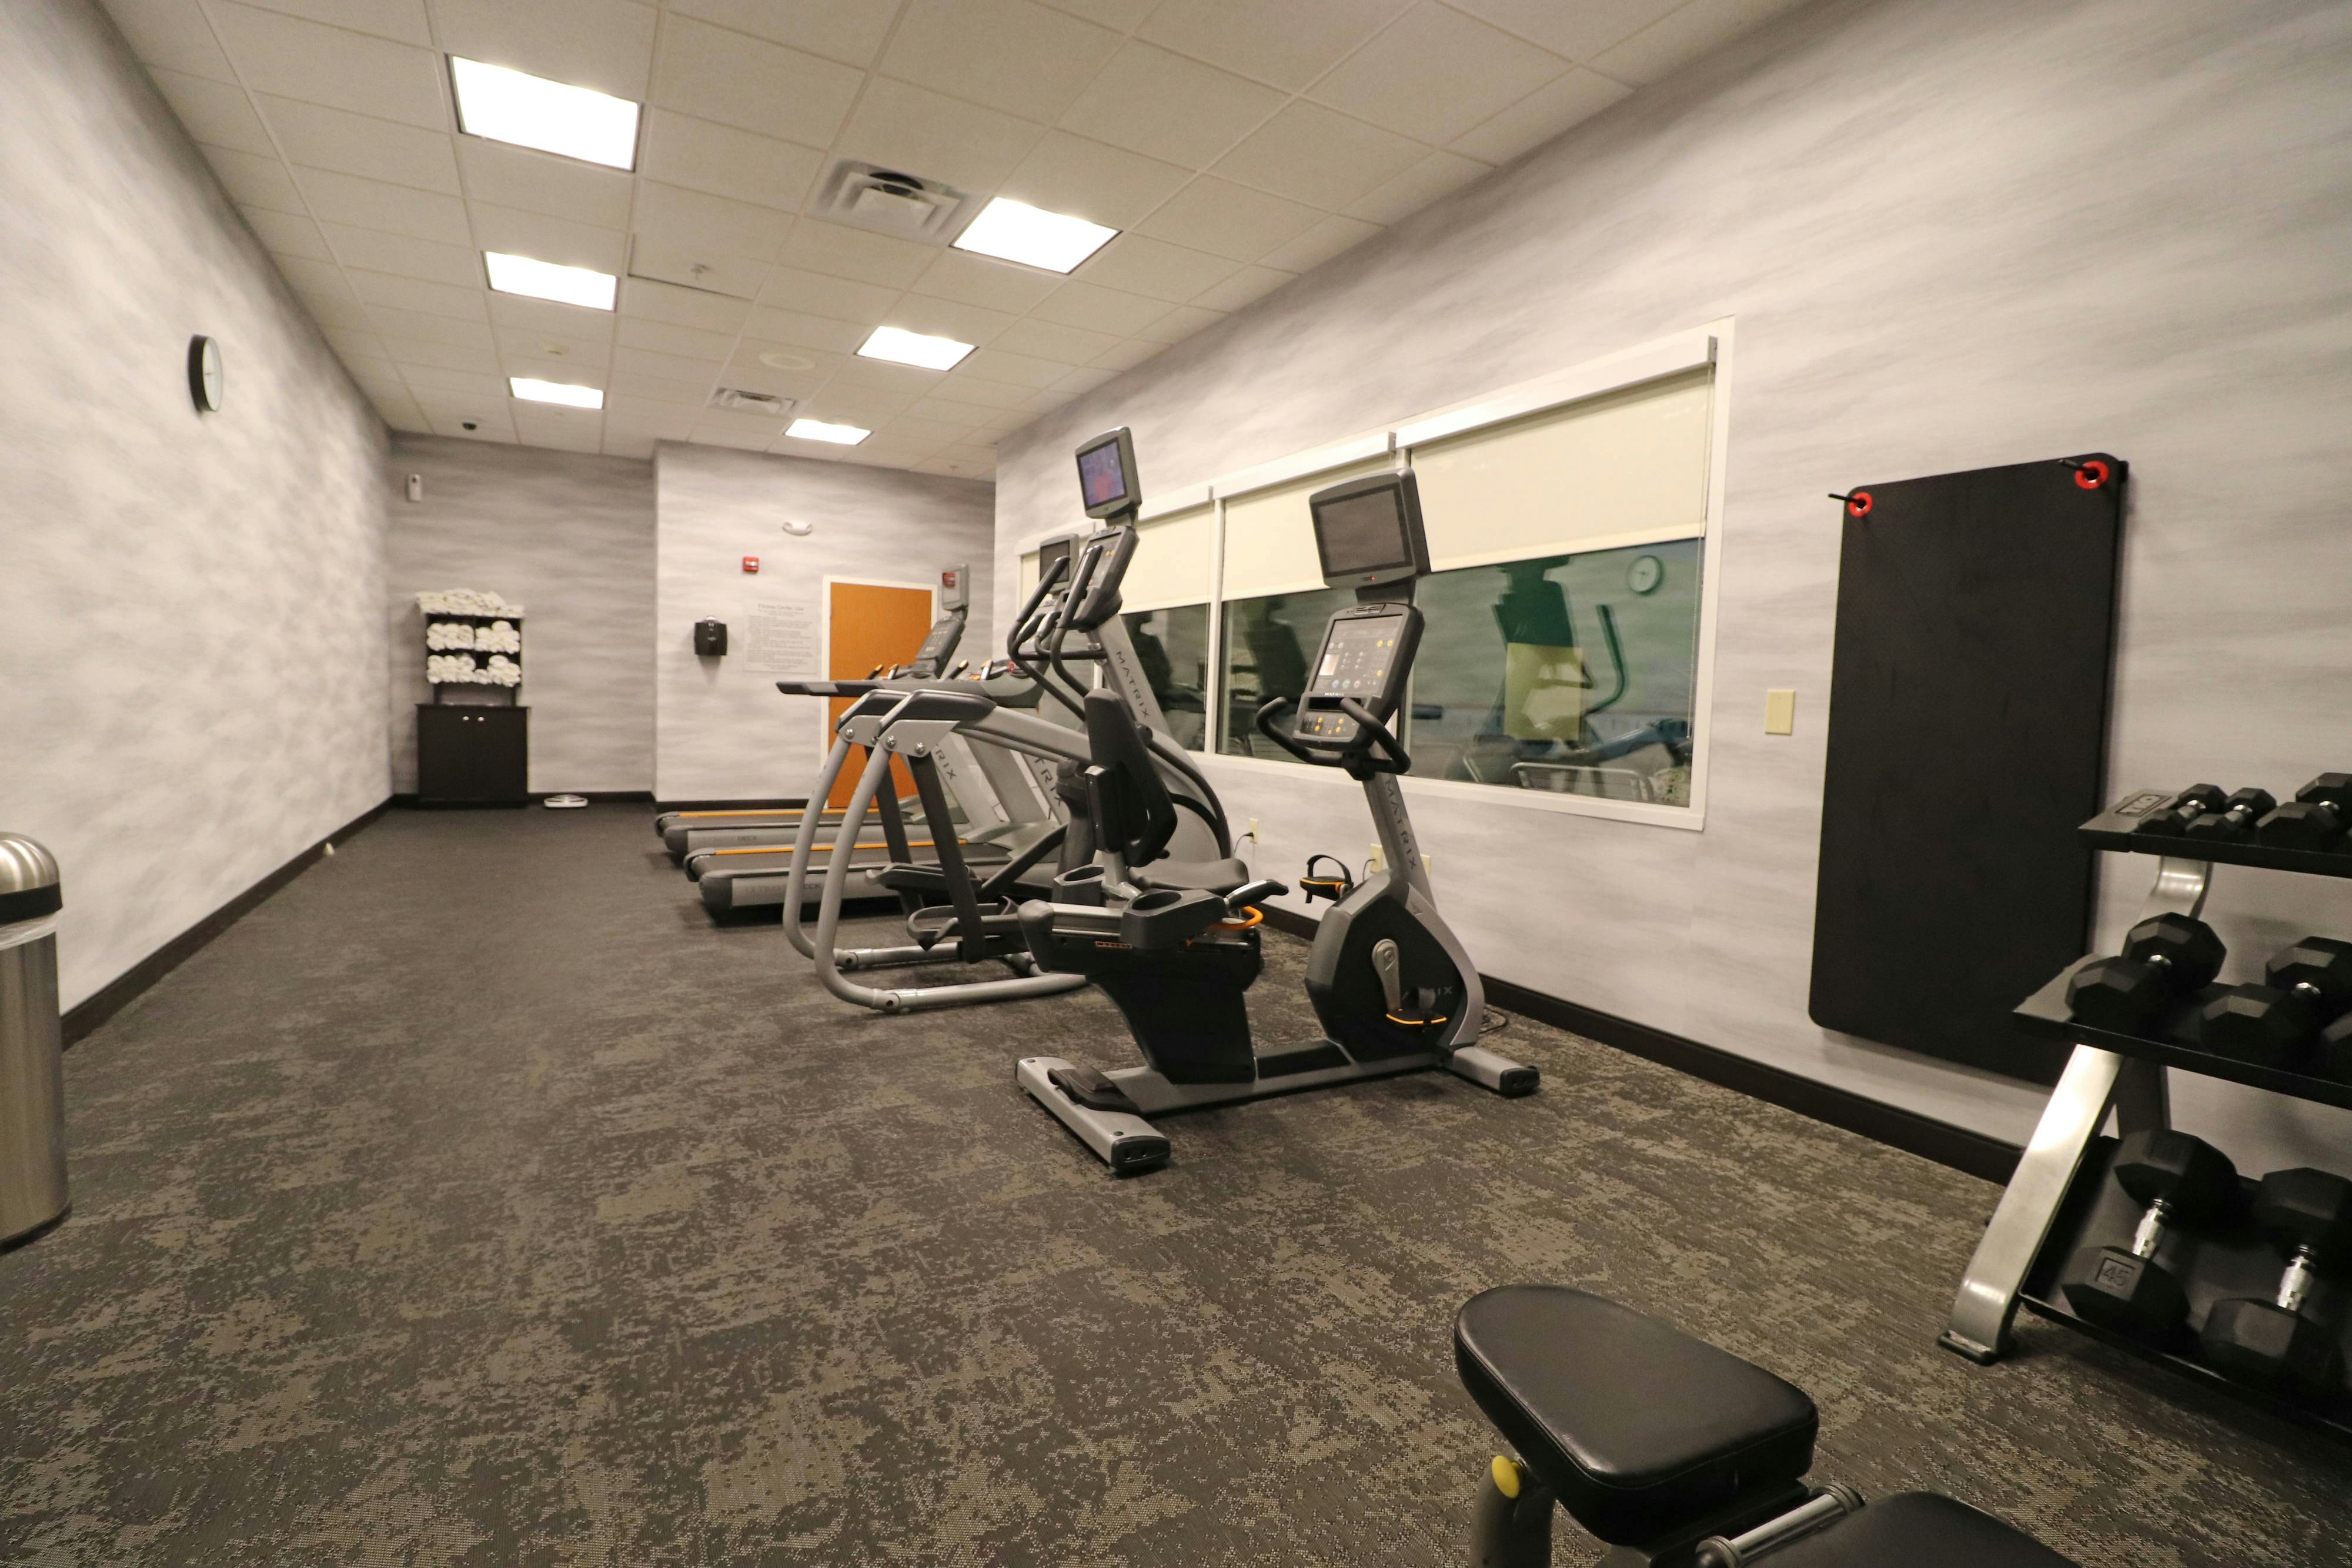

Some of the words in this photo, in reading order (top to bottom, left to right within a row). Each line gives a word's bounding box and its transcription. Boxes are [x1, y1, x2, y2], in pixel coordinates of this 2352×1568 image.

[1116, 651, 1150, 718] MATRIX
[935, 750, 957, 780] RIX
[1035, 757, 1061, 807] TRIX
[1385, 780, 1416, 870] MATRIX
[2102, 1265, 2130, 1286] 45
